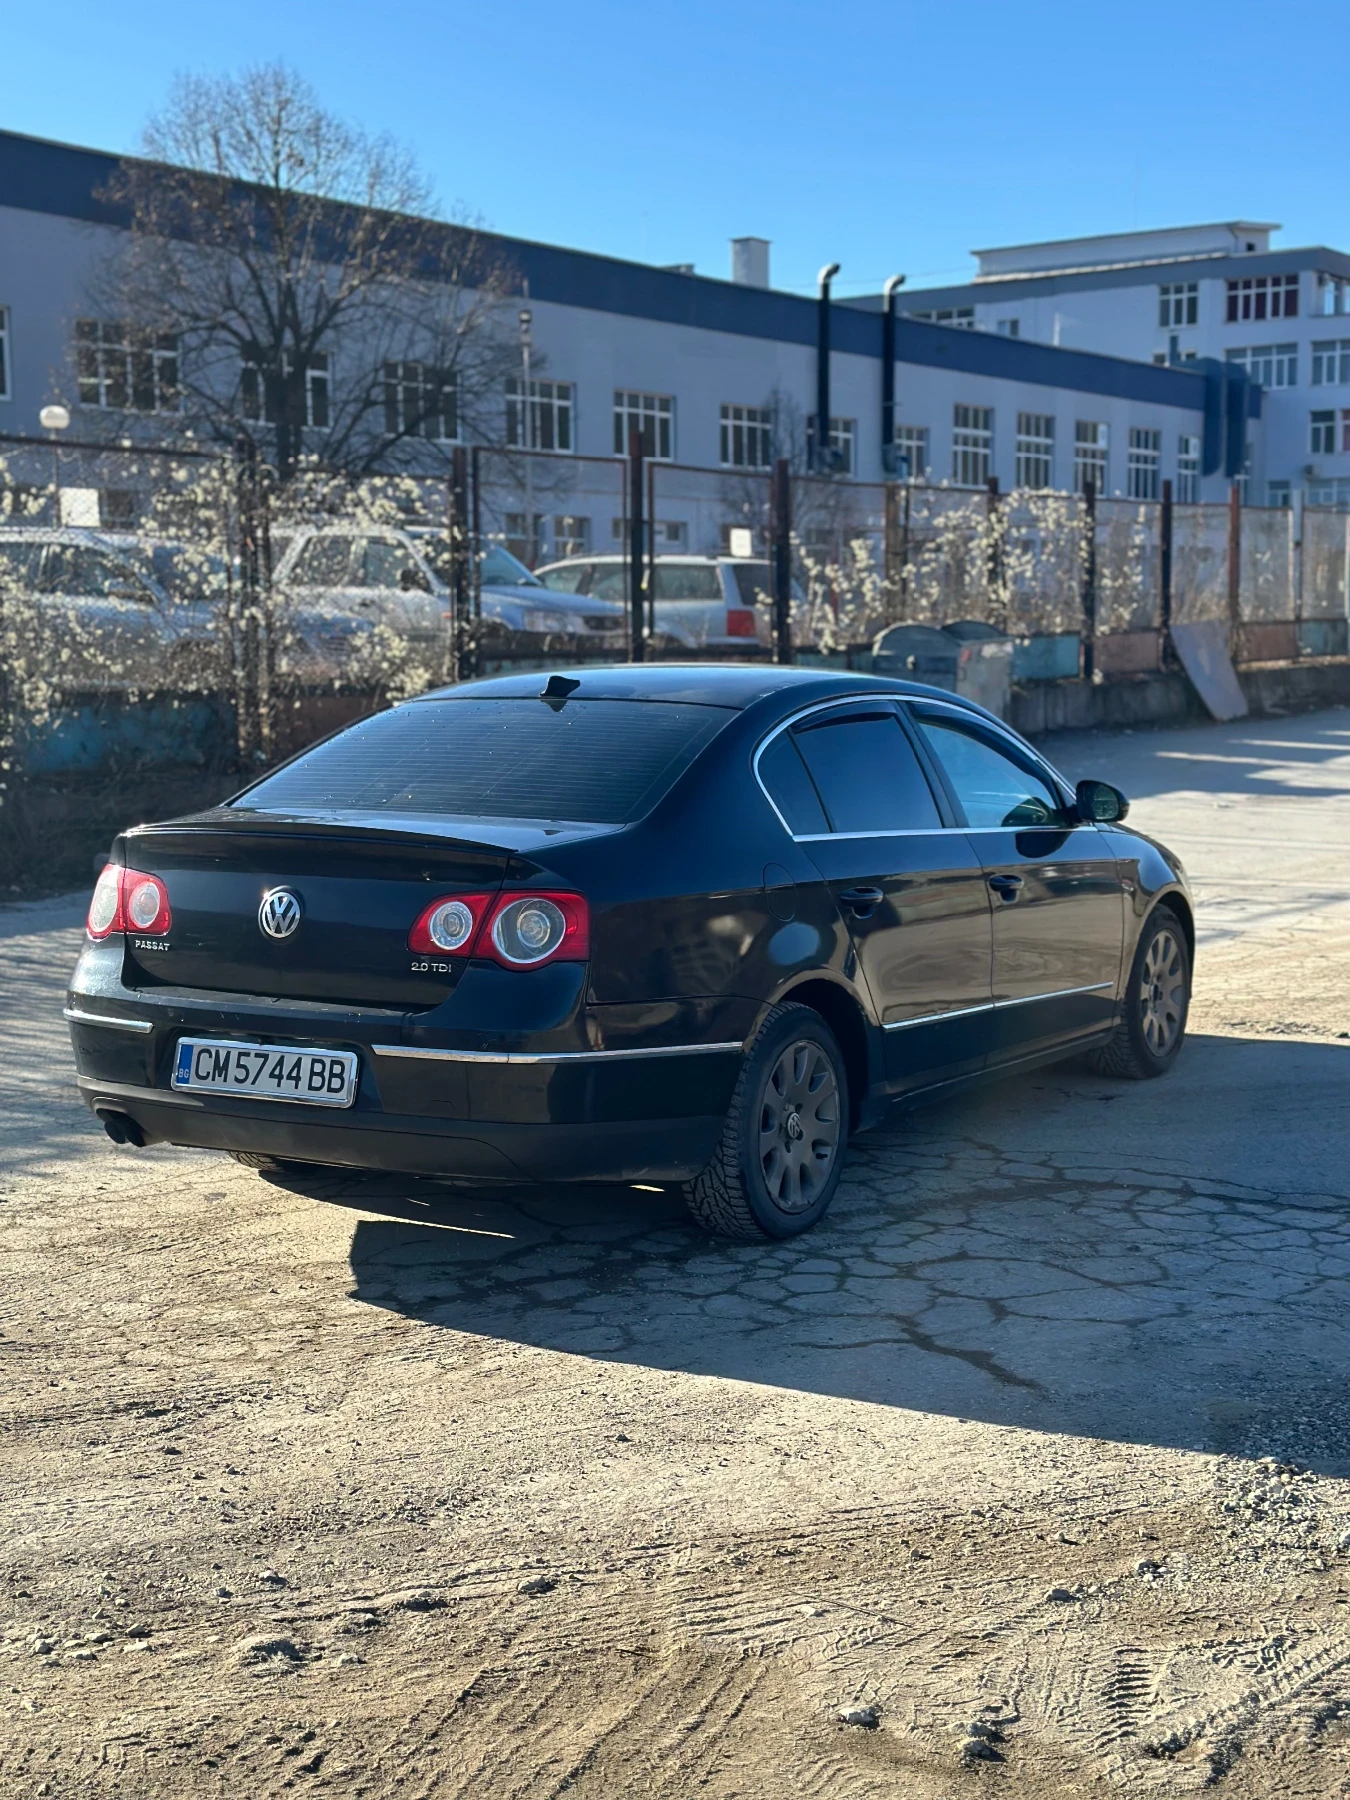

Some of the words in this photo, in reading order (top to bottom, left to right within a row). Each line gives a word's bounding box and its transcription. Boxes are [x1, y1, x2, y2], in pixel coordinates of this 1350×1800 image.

[135, 940, 170, 951] PASSAT
[430, 963, 452, 973] TDI
[178, 1068, 190, 1078] BG
